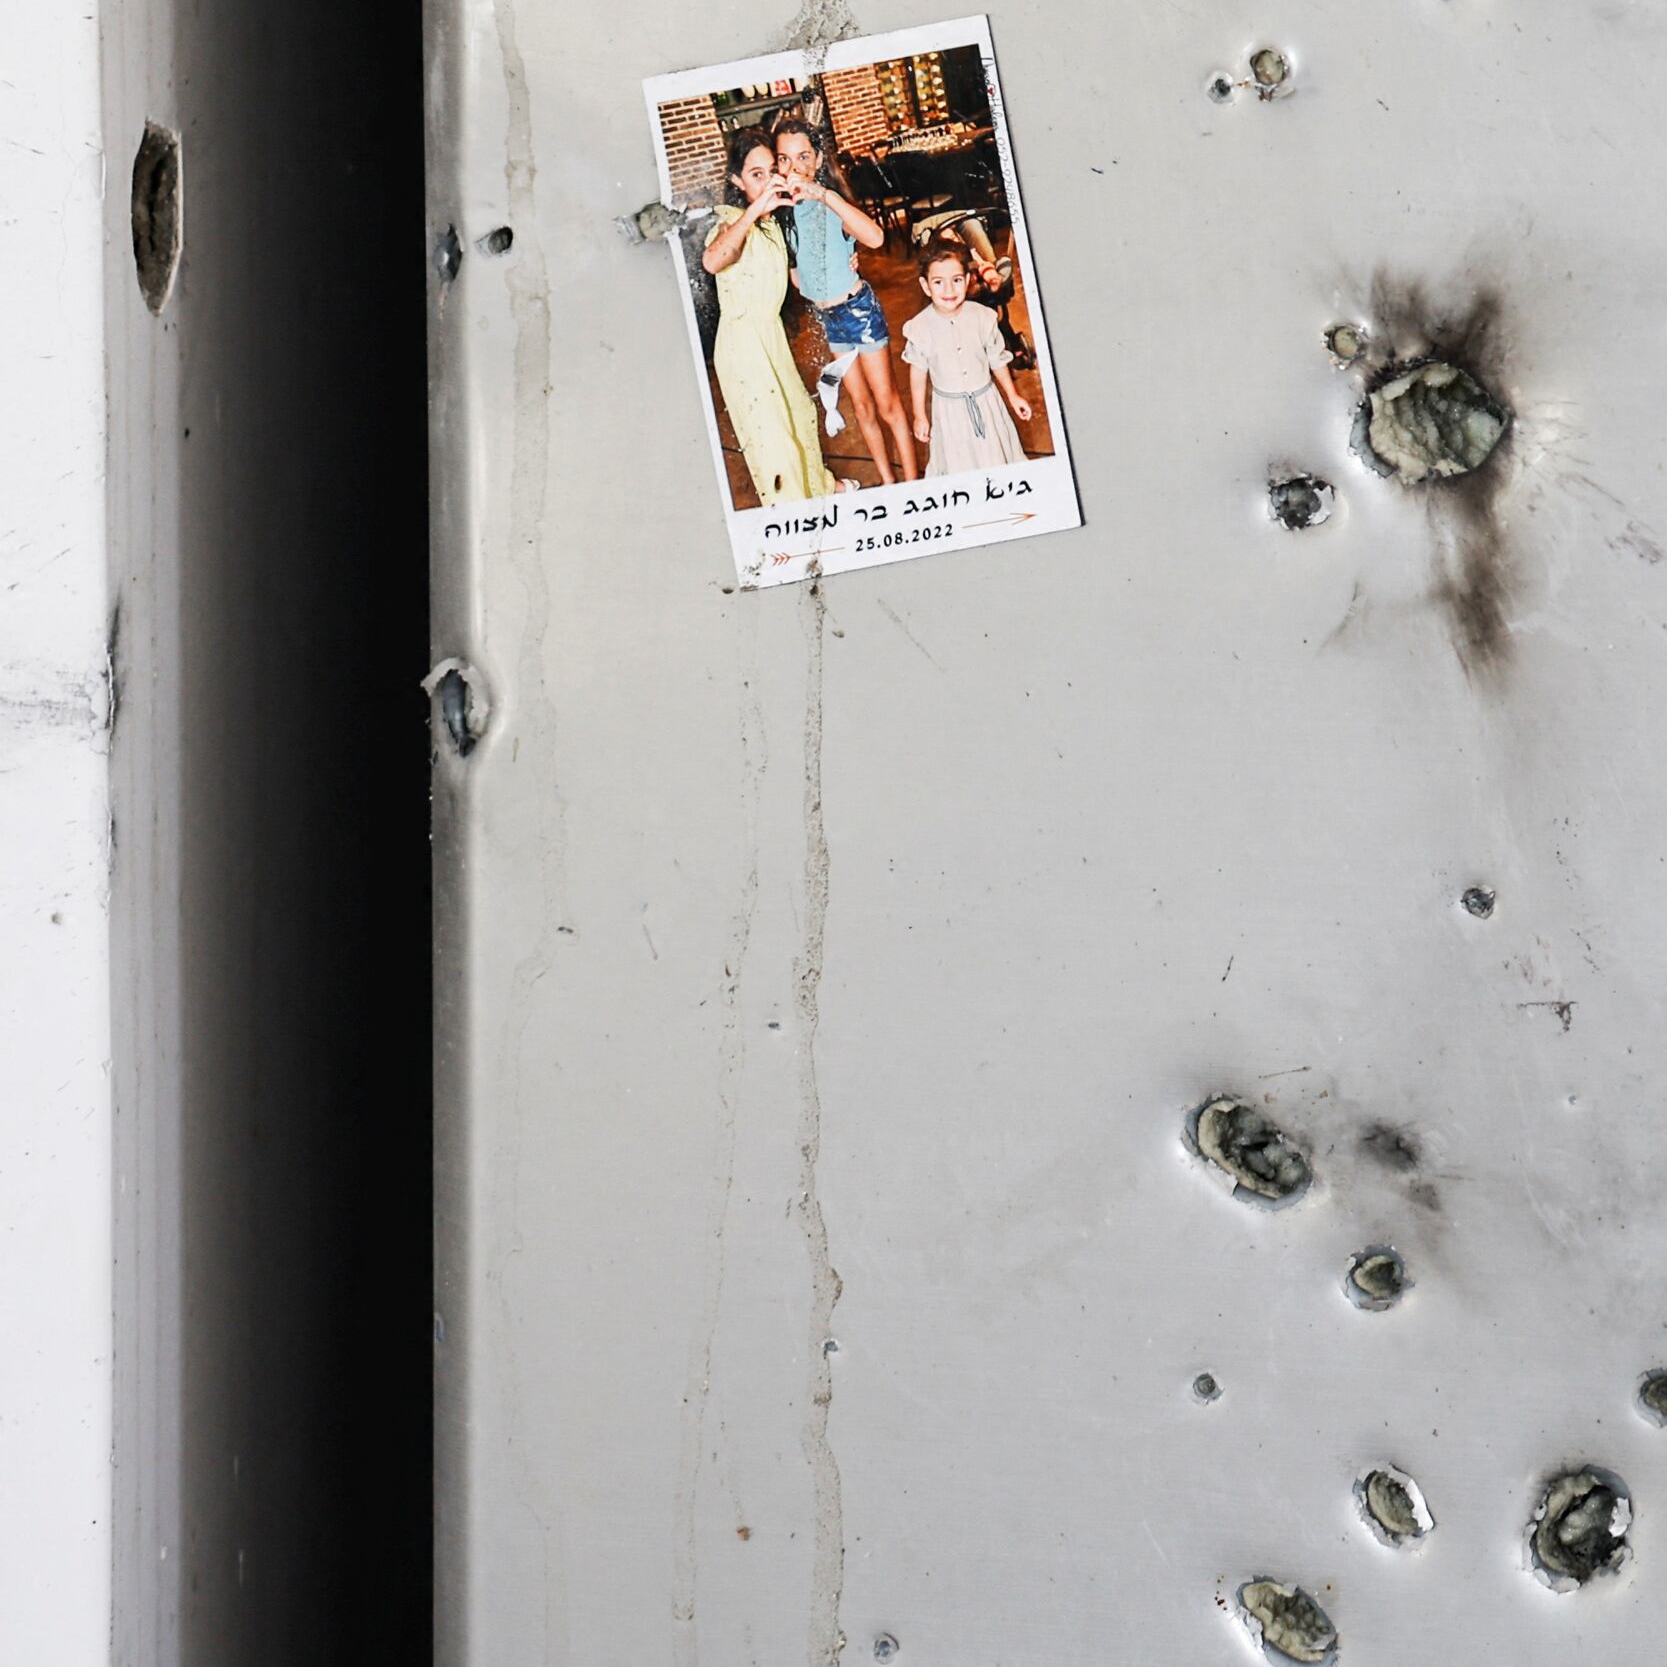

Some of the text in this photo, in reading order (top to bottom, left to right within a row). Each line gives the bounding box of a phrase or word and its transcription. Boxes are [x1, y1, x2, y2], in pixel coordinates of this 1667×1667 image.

[764, 477, 1033, 539] גיא חוגג בר מצווה
[855, 524, 954, 552] 25.08.2022
